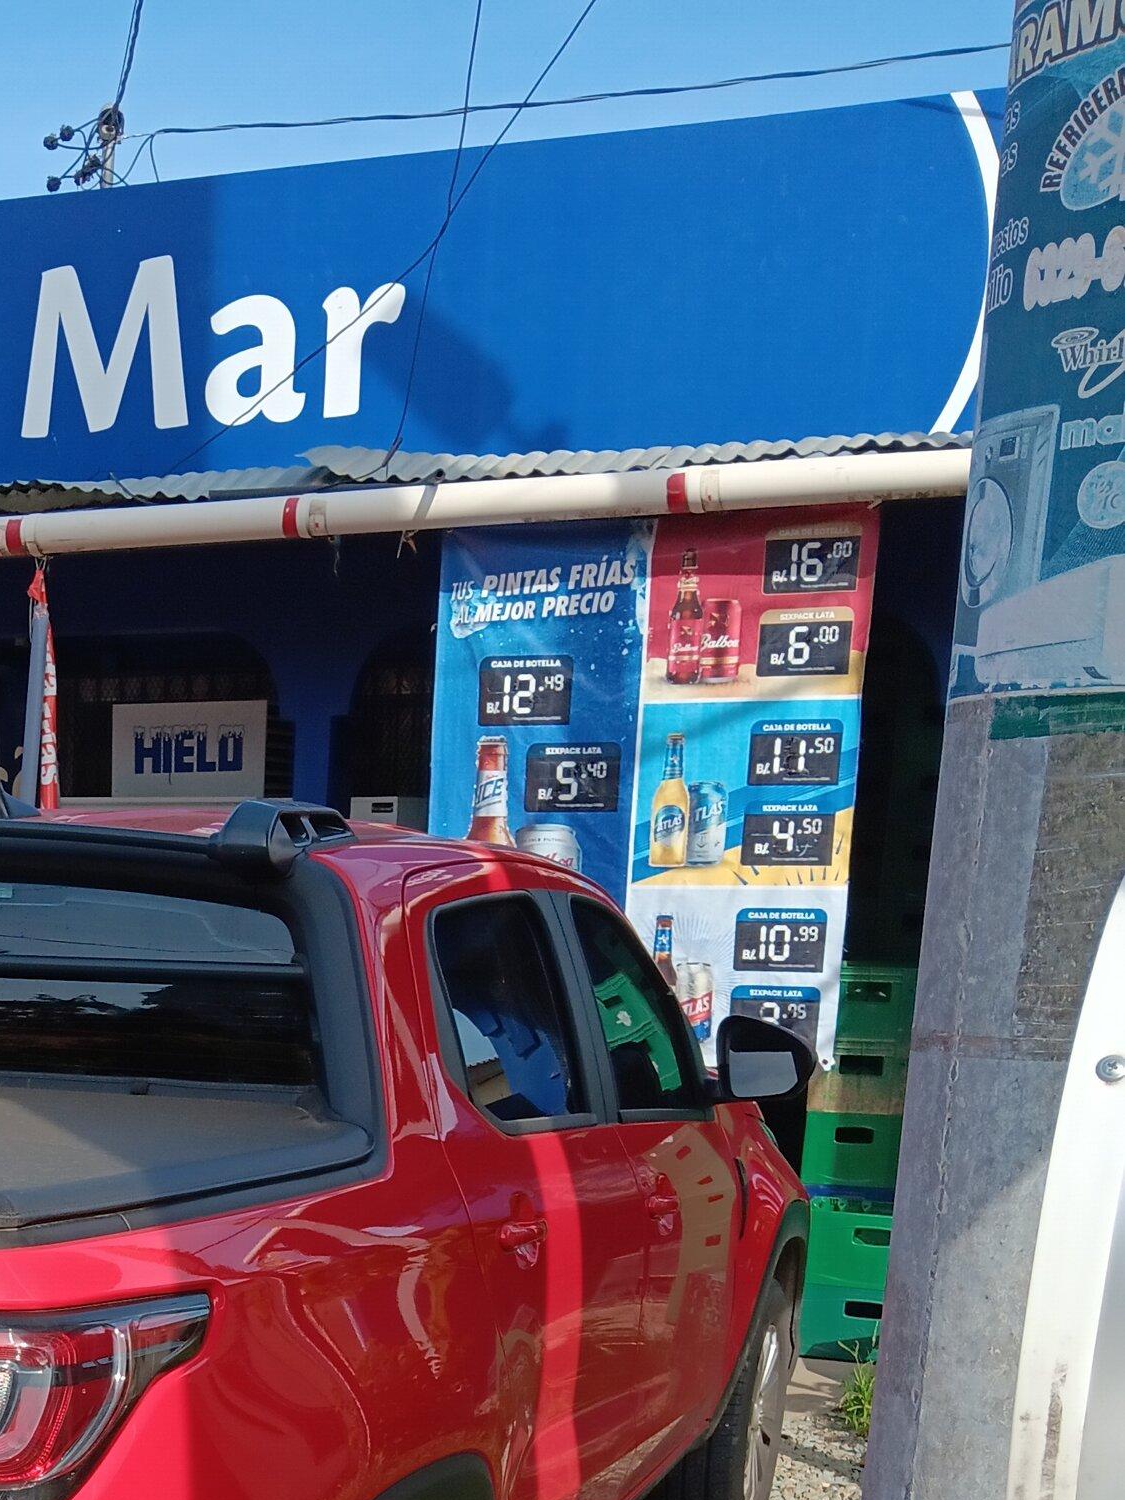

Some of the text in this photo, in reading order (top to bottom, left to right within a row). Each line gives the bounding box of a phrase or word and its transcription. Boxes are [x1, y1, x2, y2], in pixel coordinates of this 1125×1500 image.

[1009, 0, 1125, 86] RAM
[22, 255, 405, 437] Mar
[1060, 402, 1125, 450] ma
[452, 555, 637, 601] TUS PINTAS FRÍAS
[474, 600, 537, 623] MEJOR
[541, 590, 616, 618] PRECIO
[815, 611, 836, 620] LATA
[491, 659, 562, 668] CAJA DE BOTELLA
[763, 722, 831, 731] CAJA DE BOTELLA
[133, 723, 245, 775] HIELO
[582, 746, 602, 755] LATA
[798, 804, 818, 812] LATA
[748, 912, 816, 920] CAJA DE BOTELLA
[782, 989, 803, 998] LATA
